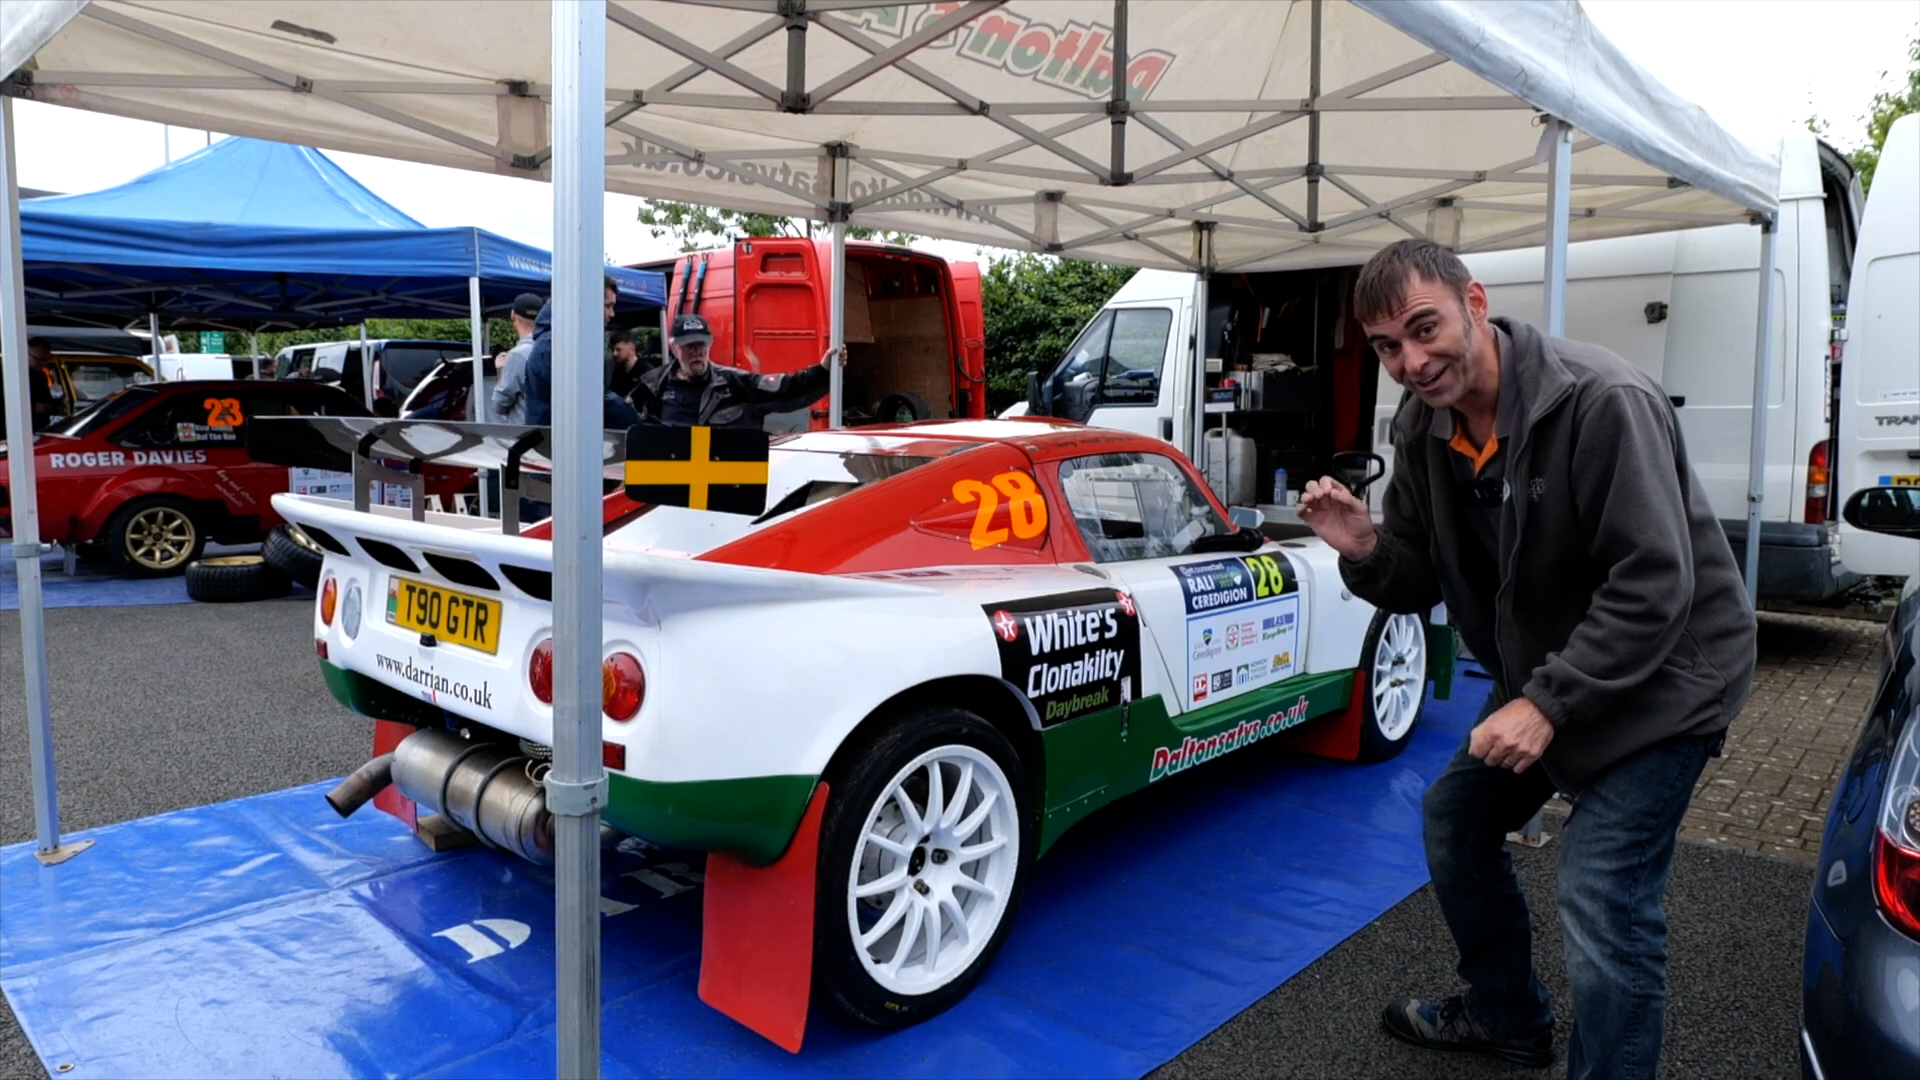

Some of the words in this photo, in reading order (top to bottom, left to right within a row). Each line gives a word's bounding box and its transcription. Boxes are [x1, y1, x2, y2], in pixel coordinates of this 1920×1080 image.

[203, 397, 244, 427] 23
[49, 451, 126, 468] ROGER
[132, 449, 207, 465] DAVIES
[952, 471, 1048, 551] 28
[1186, 574, 1216, 594] RALI
[1191, 586, 1248, 611] CEREDIGION
[1245, 555, 1284, 598] 28
[405, 584, 441, 630] T90
[446, 596, 488, 644] GTR
[1023, 607, 1118, 656] White's
[376, 653, 493, 710] www.darrian.co.uk
[1027, 648, 1125, 699] Clonakilty
[1045, 685, 1109, 720] Daybreak
[1149, 694, 1309, 782] Daltonsatvs.co.uk
